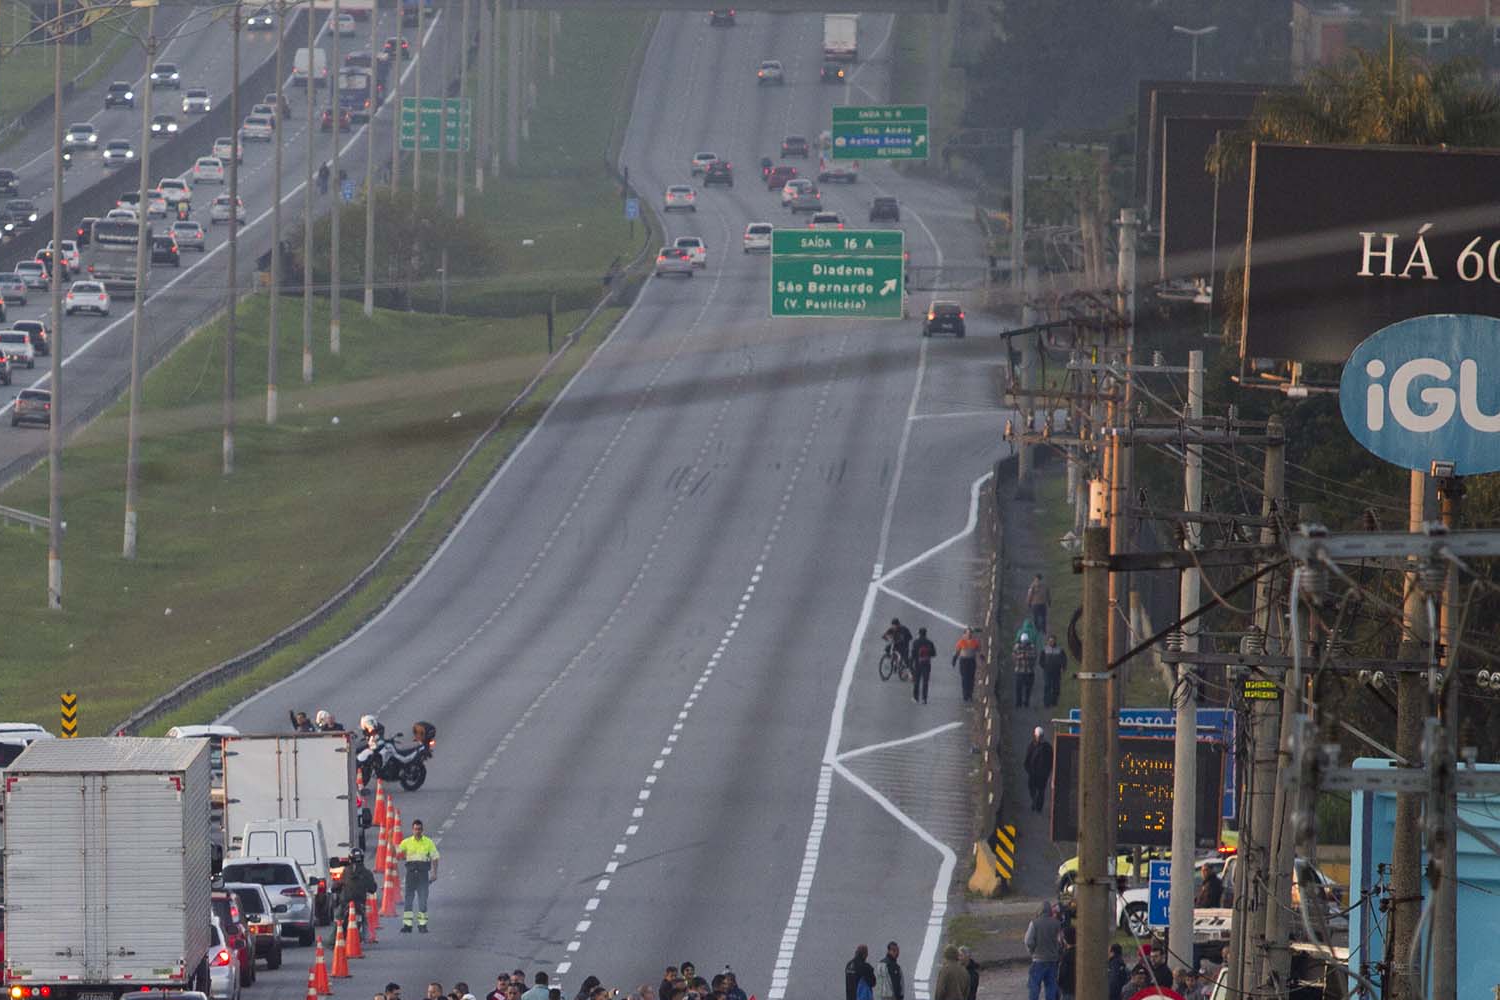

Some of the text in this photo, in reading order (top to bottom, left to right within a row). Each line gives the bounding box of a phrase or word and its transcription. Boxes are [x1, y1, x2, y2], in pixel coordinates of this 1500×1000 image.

[801, 235, 874, 249] SAÍDA 16 A
[1357, 223, 1439, 279] HÁ
[812, 264, 874, 276] Diadema
[777, 280, 874, 294] São Bernardo
